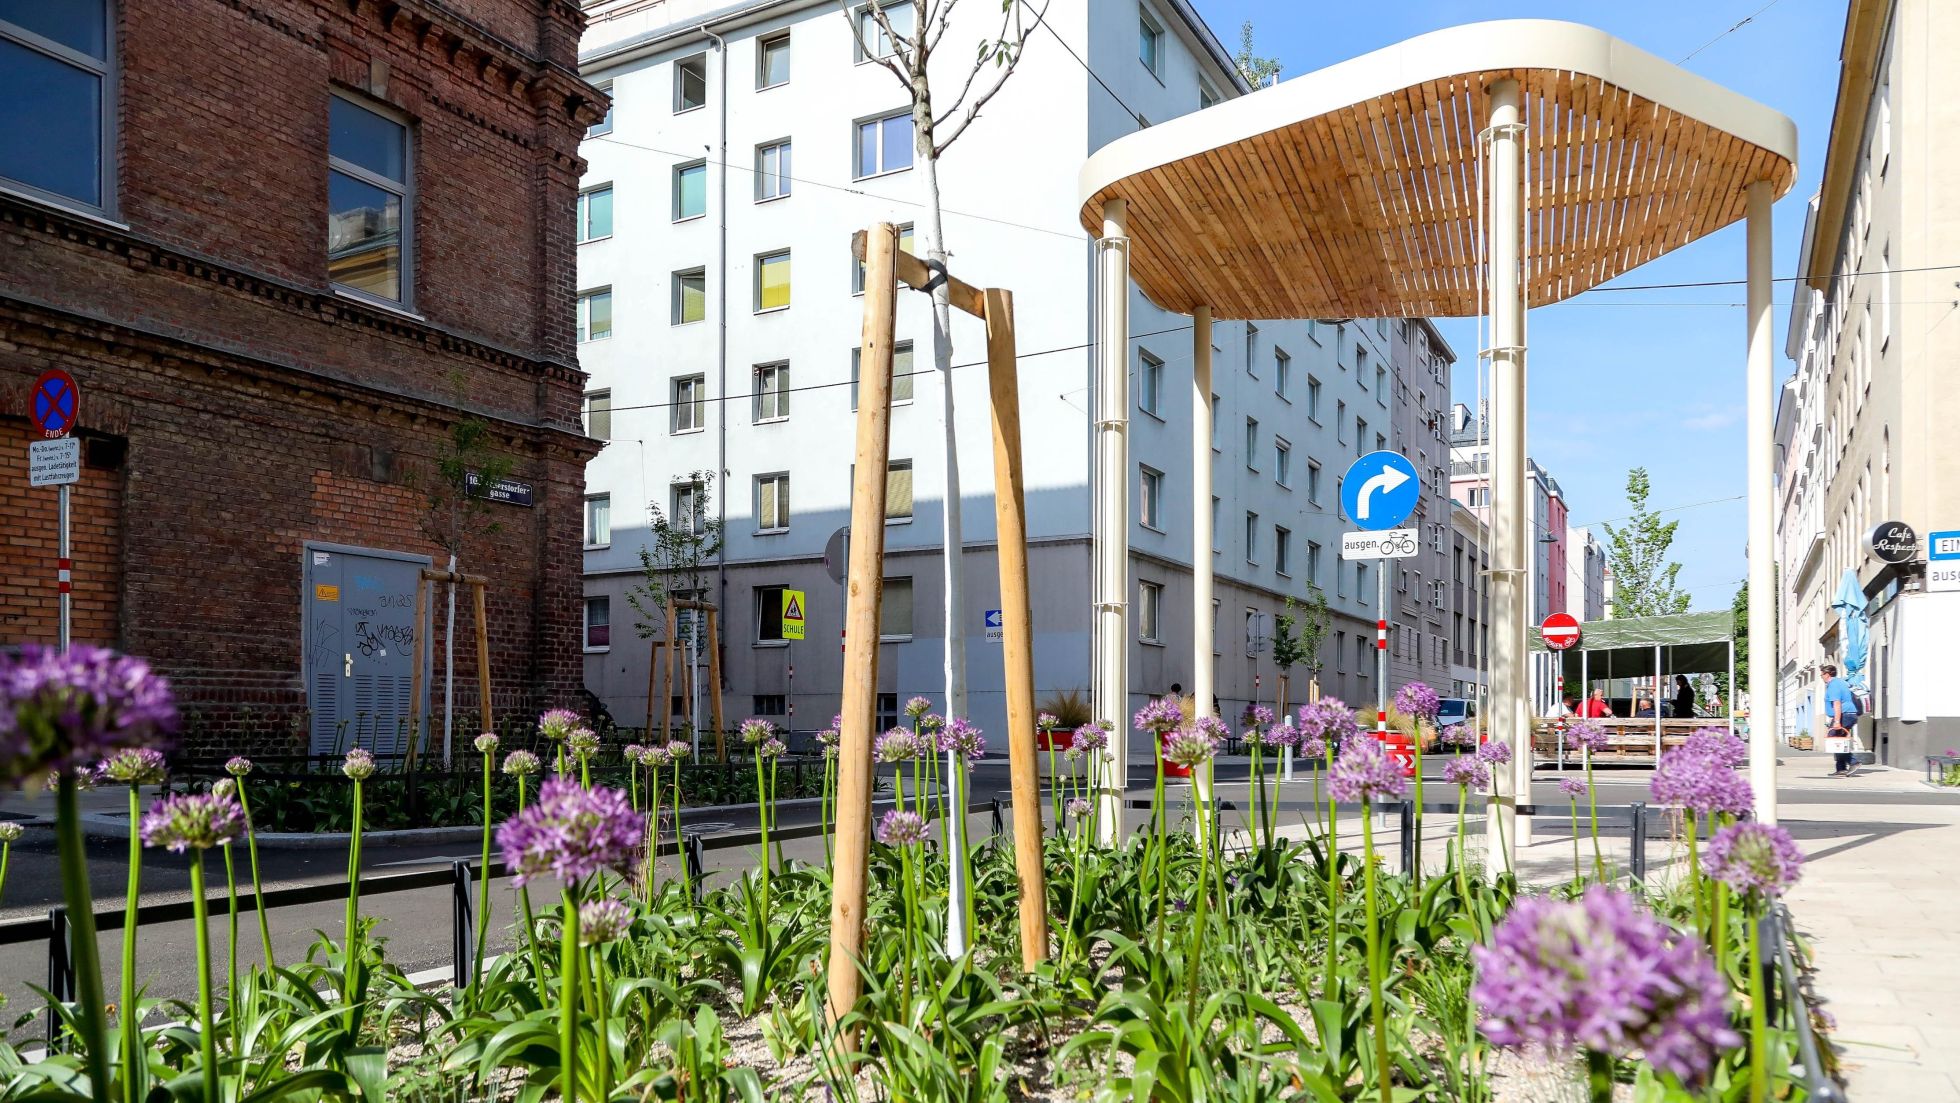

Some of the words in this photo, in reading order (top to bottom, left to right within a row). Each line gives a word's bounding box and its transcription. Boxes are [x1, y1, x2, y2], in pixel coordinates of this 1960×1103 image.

[46, 428, 63, 438] ENDE
[490, 489, 510, 499] gasse
[1888, 528, 1912, 542] Cafe
[1344, 541, 1379, 551] ausgen.
[1874, 539, 1916, 554] Respect
[784, 624, 803, 634] SCHULE
